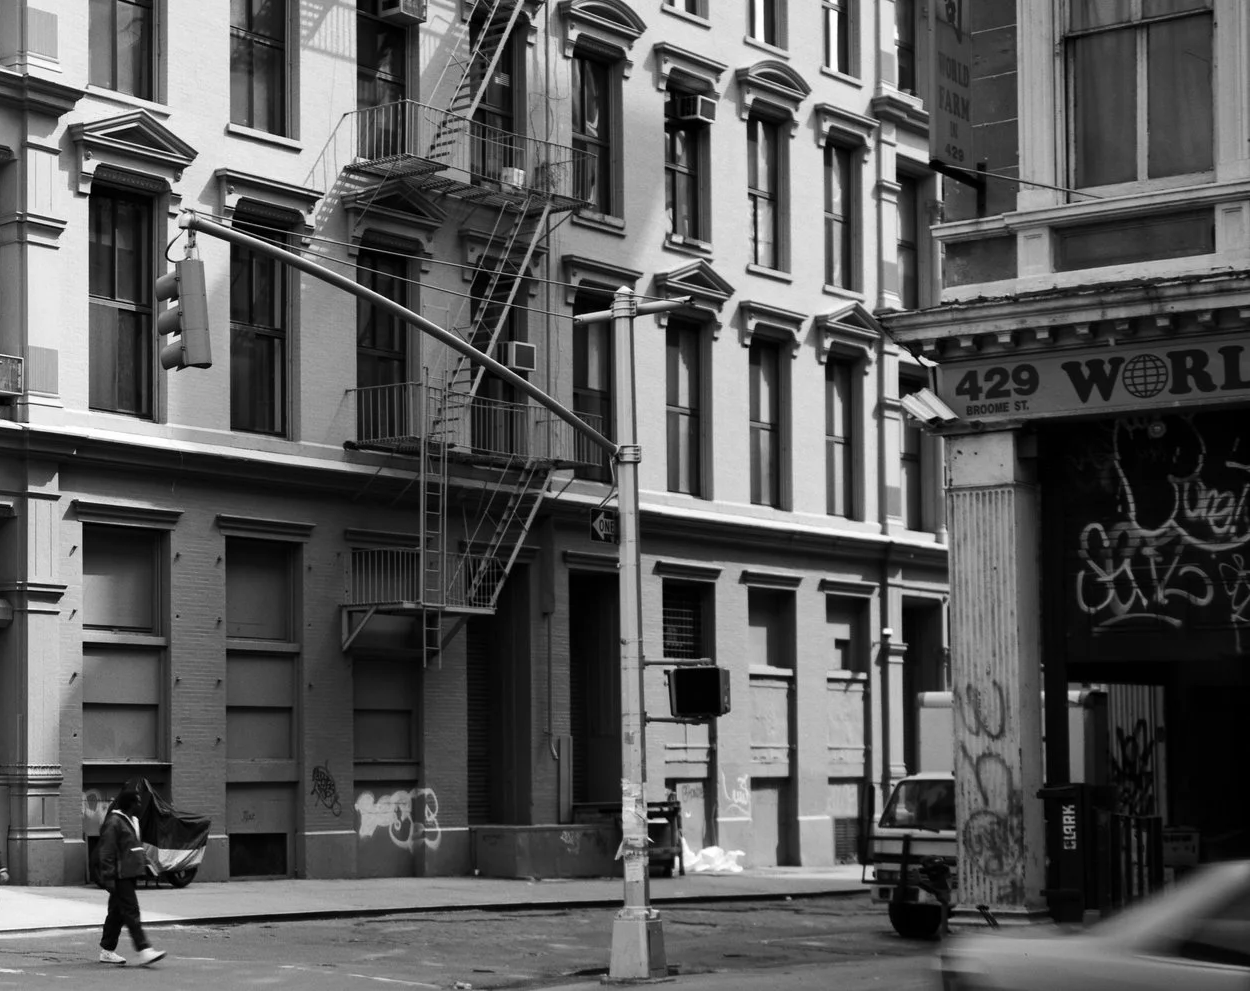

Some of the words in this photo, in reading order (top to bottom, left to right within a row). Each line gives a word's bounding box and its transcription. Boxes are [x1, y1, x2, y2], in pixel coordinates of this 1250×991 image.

[938, 51, 970, 88] WORLD
[939, 85, 970, 122] FARM
[944, 143, 964, 162] 429
[955, 363, 1039, 402] 429
[966, 401, 1009, 416] BROOME
[1014, 399, 1029, 412] ST.
[1062, 805, 1076, 850] CLARK
